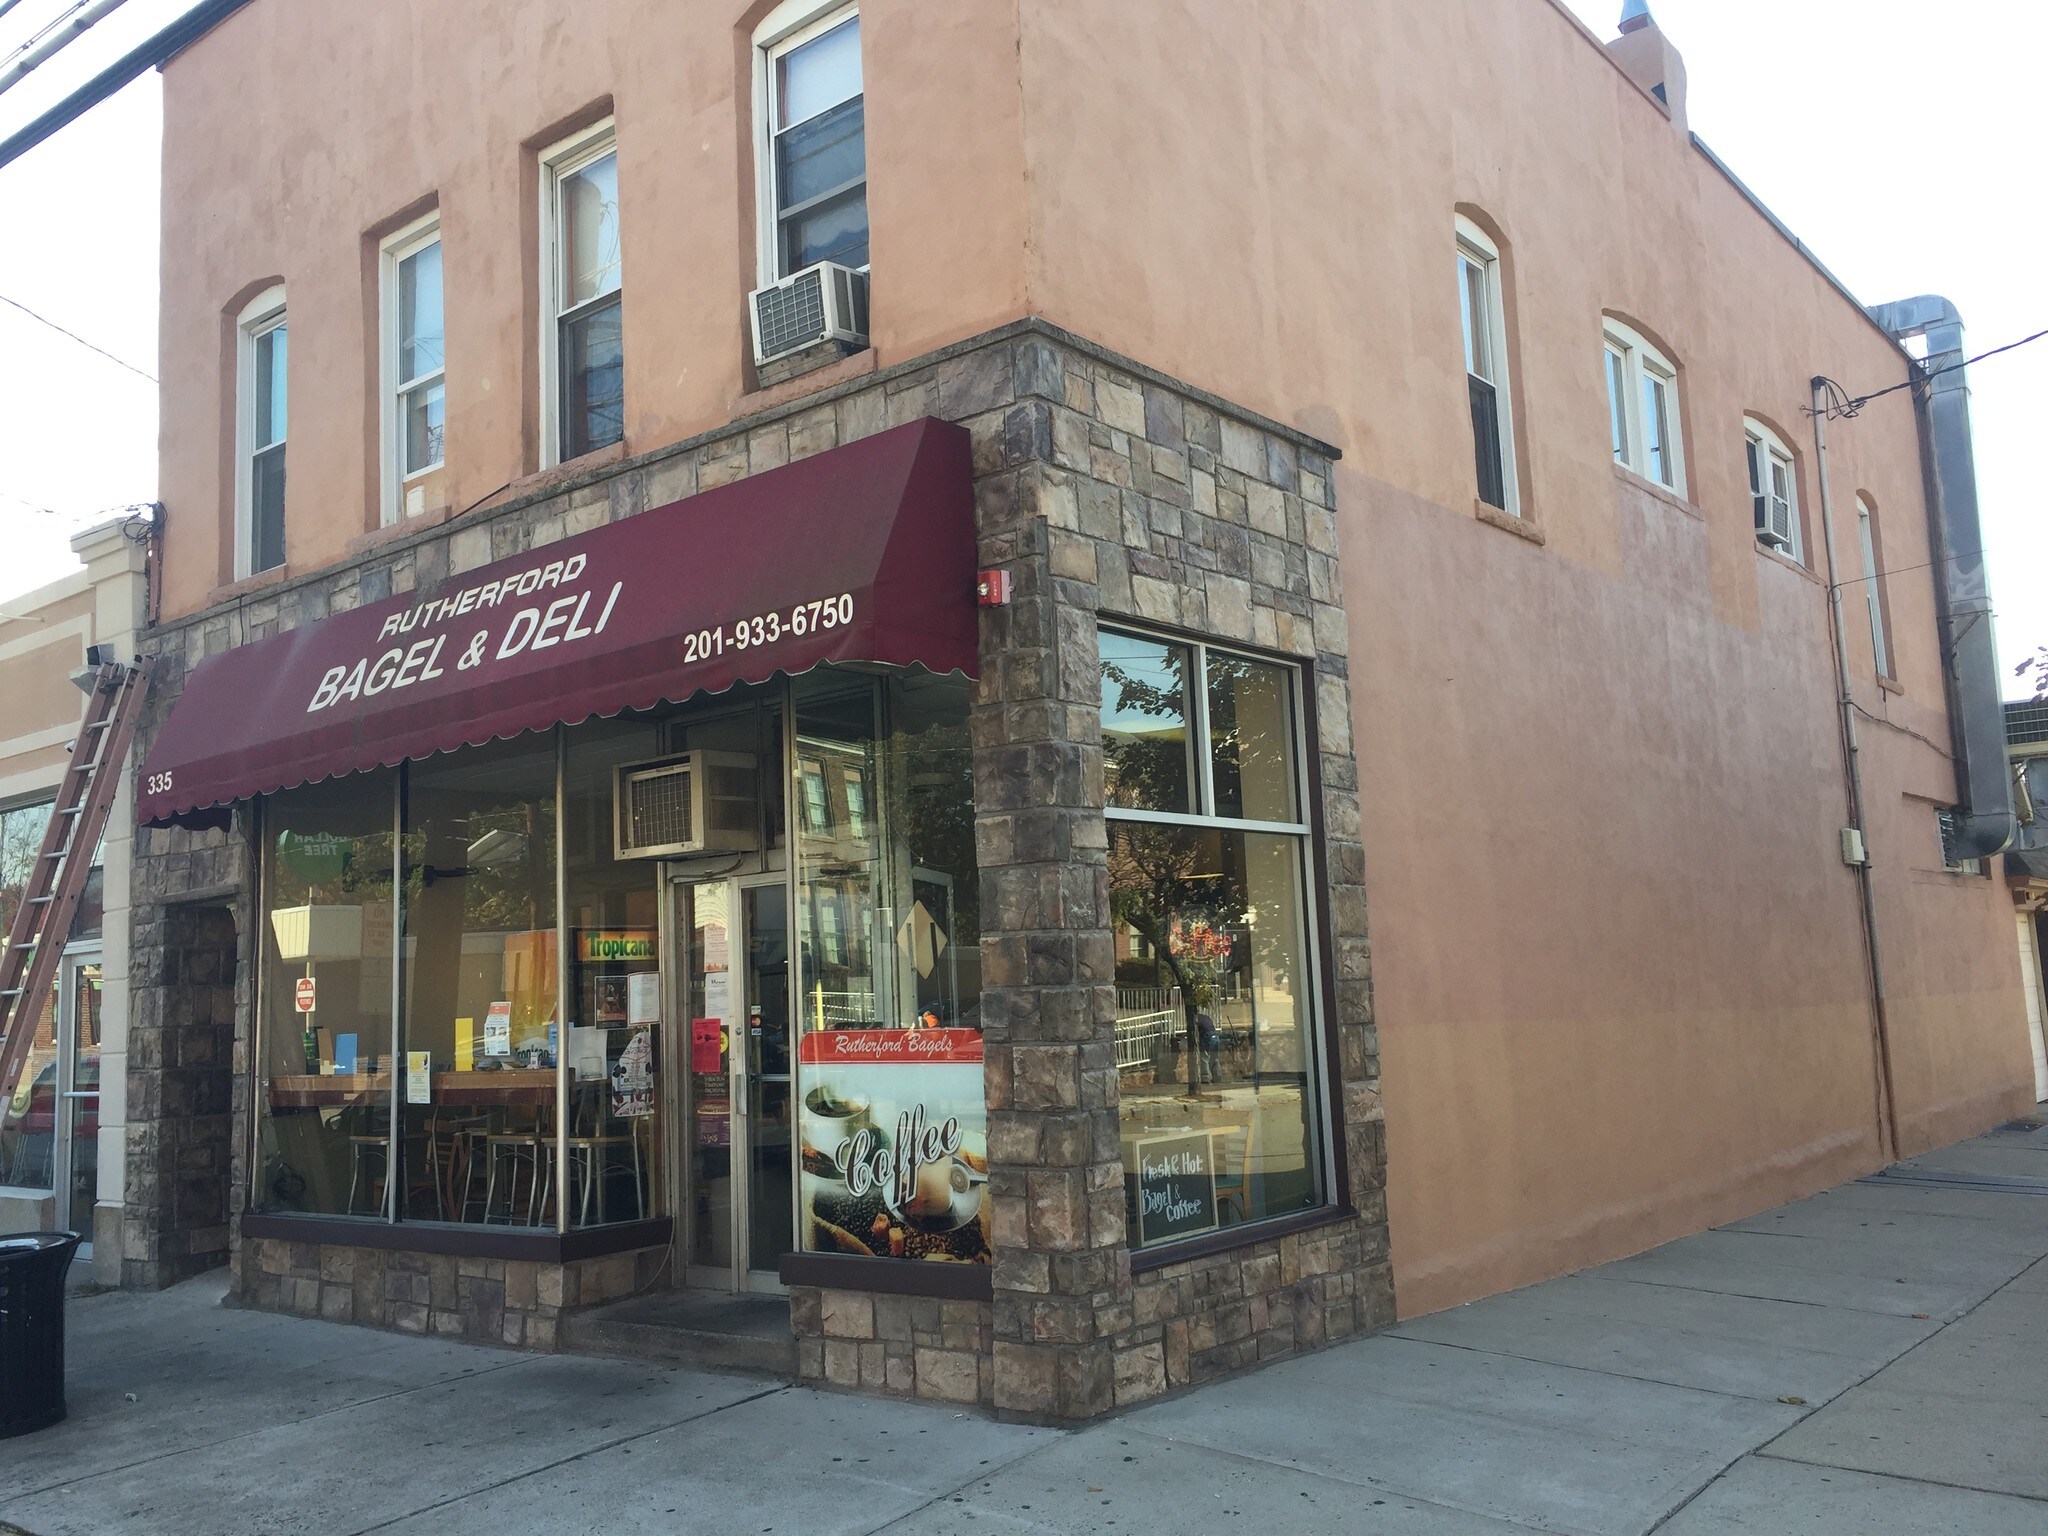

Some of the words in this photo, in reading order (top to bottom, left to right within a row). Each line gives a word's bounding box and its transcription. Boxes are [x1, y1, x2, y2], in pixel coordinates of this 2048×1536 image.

[376, 553, 587, 643] RUTHERFORD
[684, 593, 854, 663] 201-933-6750
[307, 634, 447, 713] BAGEL
[456, 629, 489, 671] &
[496, 581, 623, 660] DELI
[147, 771, 173, 795] 335
[586, 931, 656, 960] Tropicana
[835, 1033, 904, 1059] Rutherford
[834, 1101, 963, 1210] Coffee
[1142, 1152, 1171, 1182] Fresh
[1171, 1154, 1180, 1175] &
[1182, 1151, 1204, 1175] Hot
[1142, 1183, 1172, 1216] Bagel
[1175, 1184, 1181, 1199] &
